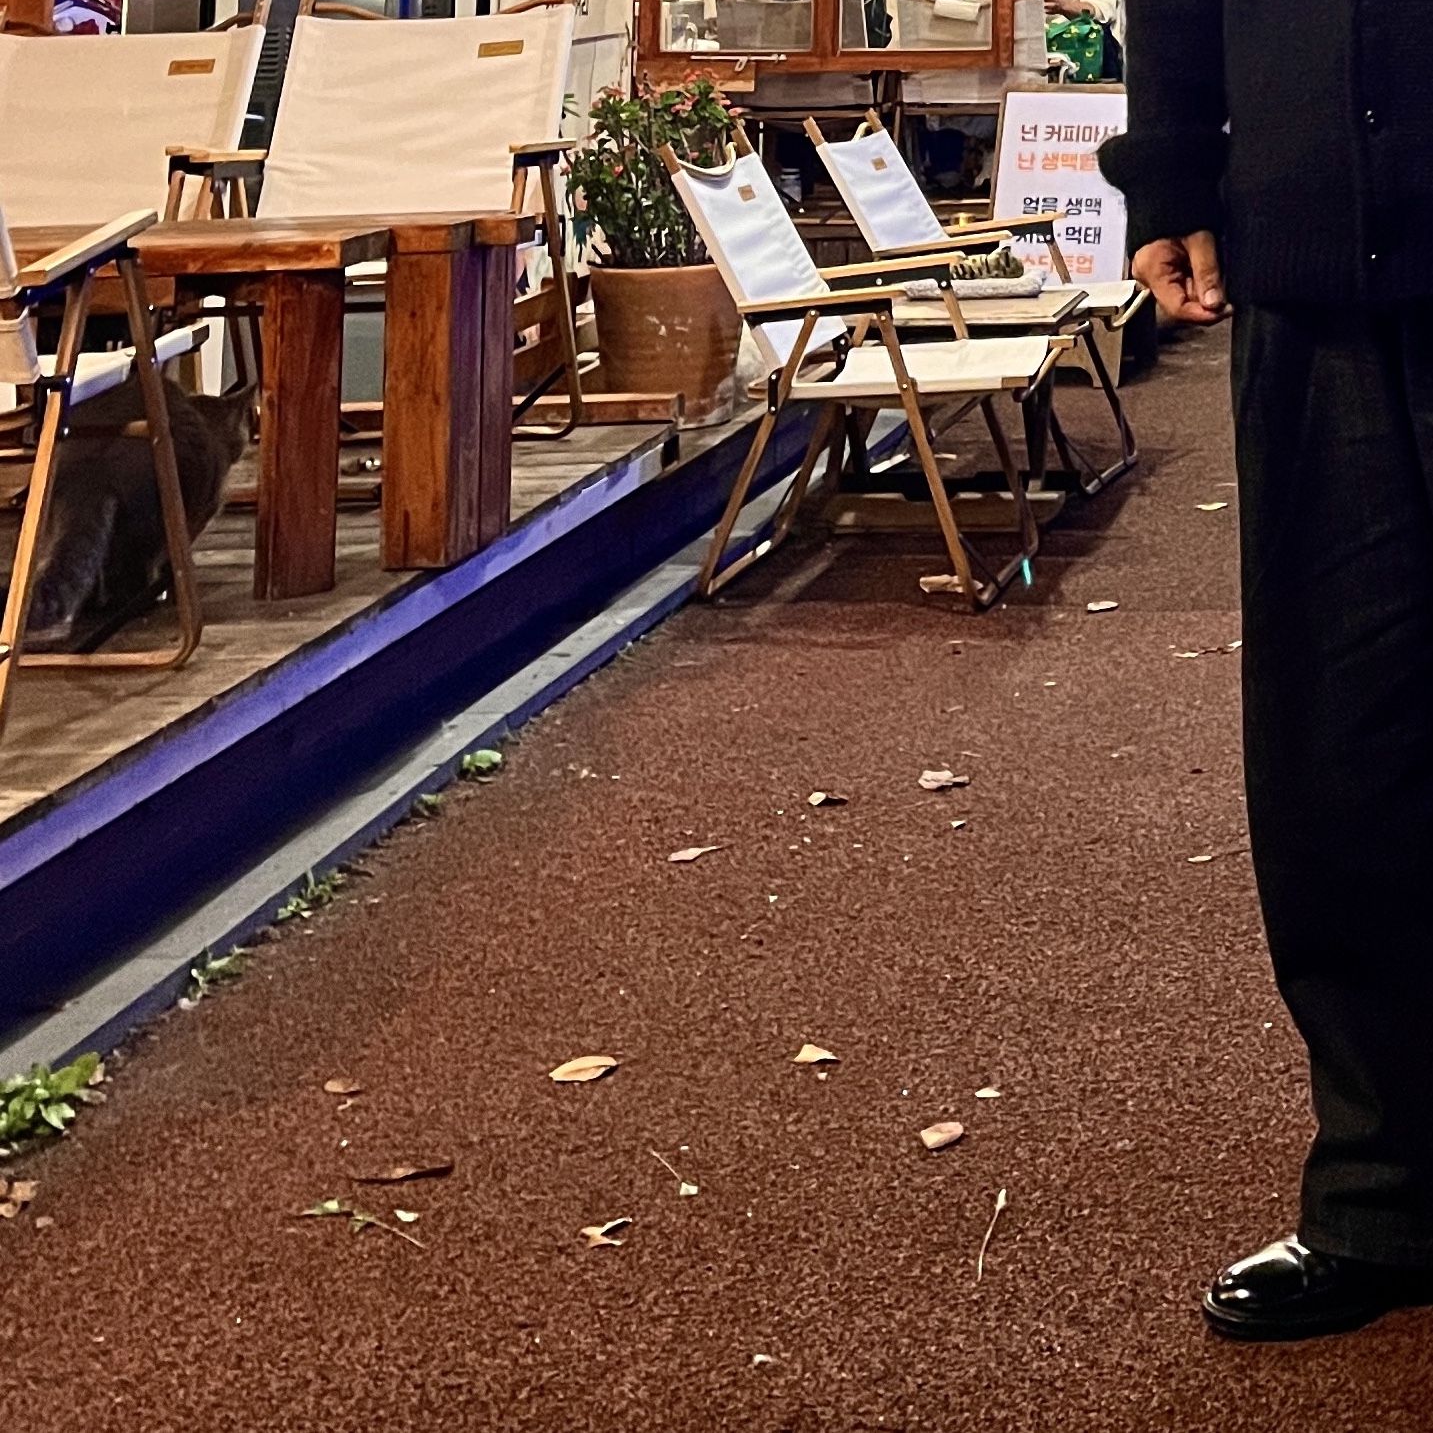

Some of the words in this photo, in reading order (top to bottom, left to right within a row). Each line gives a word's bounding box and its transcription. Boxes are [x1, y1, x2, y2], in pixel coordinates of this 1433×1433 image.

[1021, 124, 1038, 142] 넌
[1017, 151, 1036, 171] 난
[1022, 197, 1058, 215] 얼음
[1066, 197, 1102, 216] 생맥
